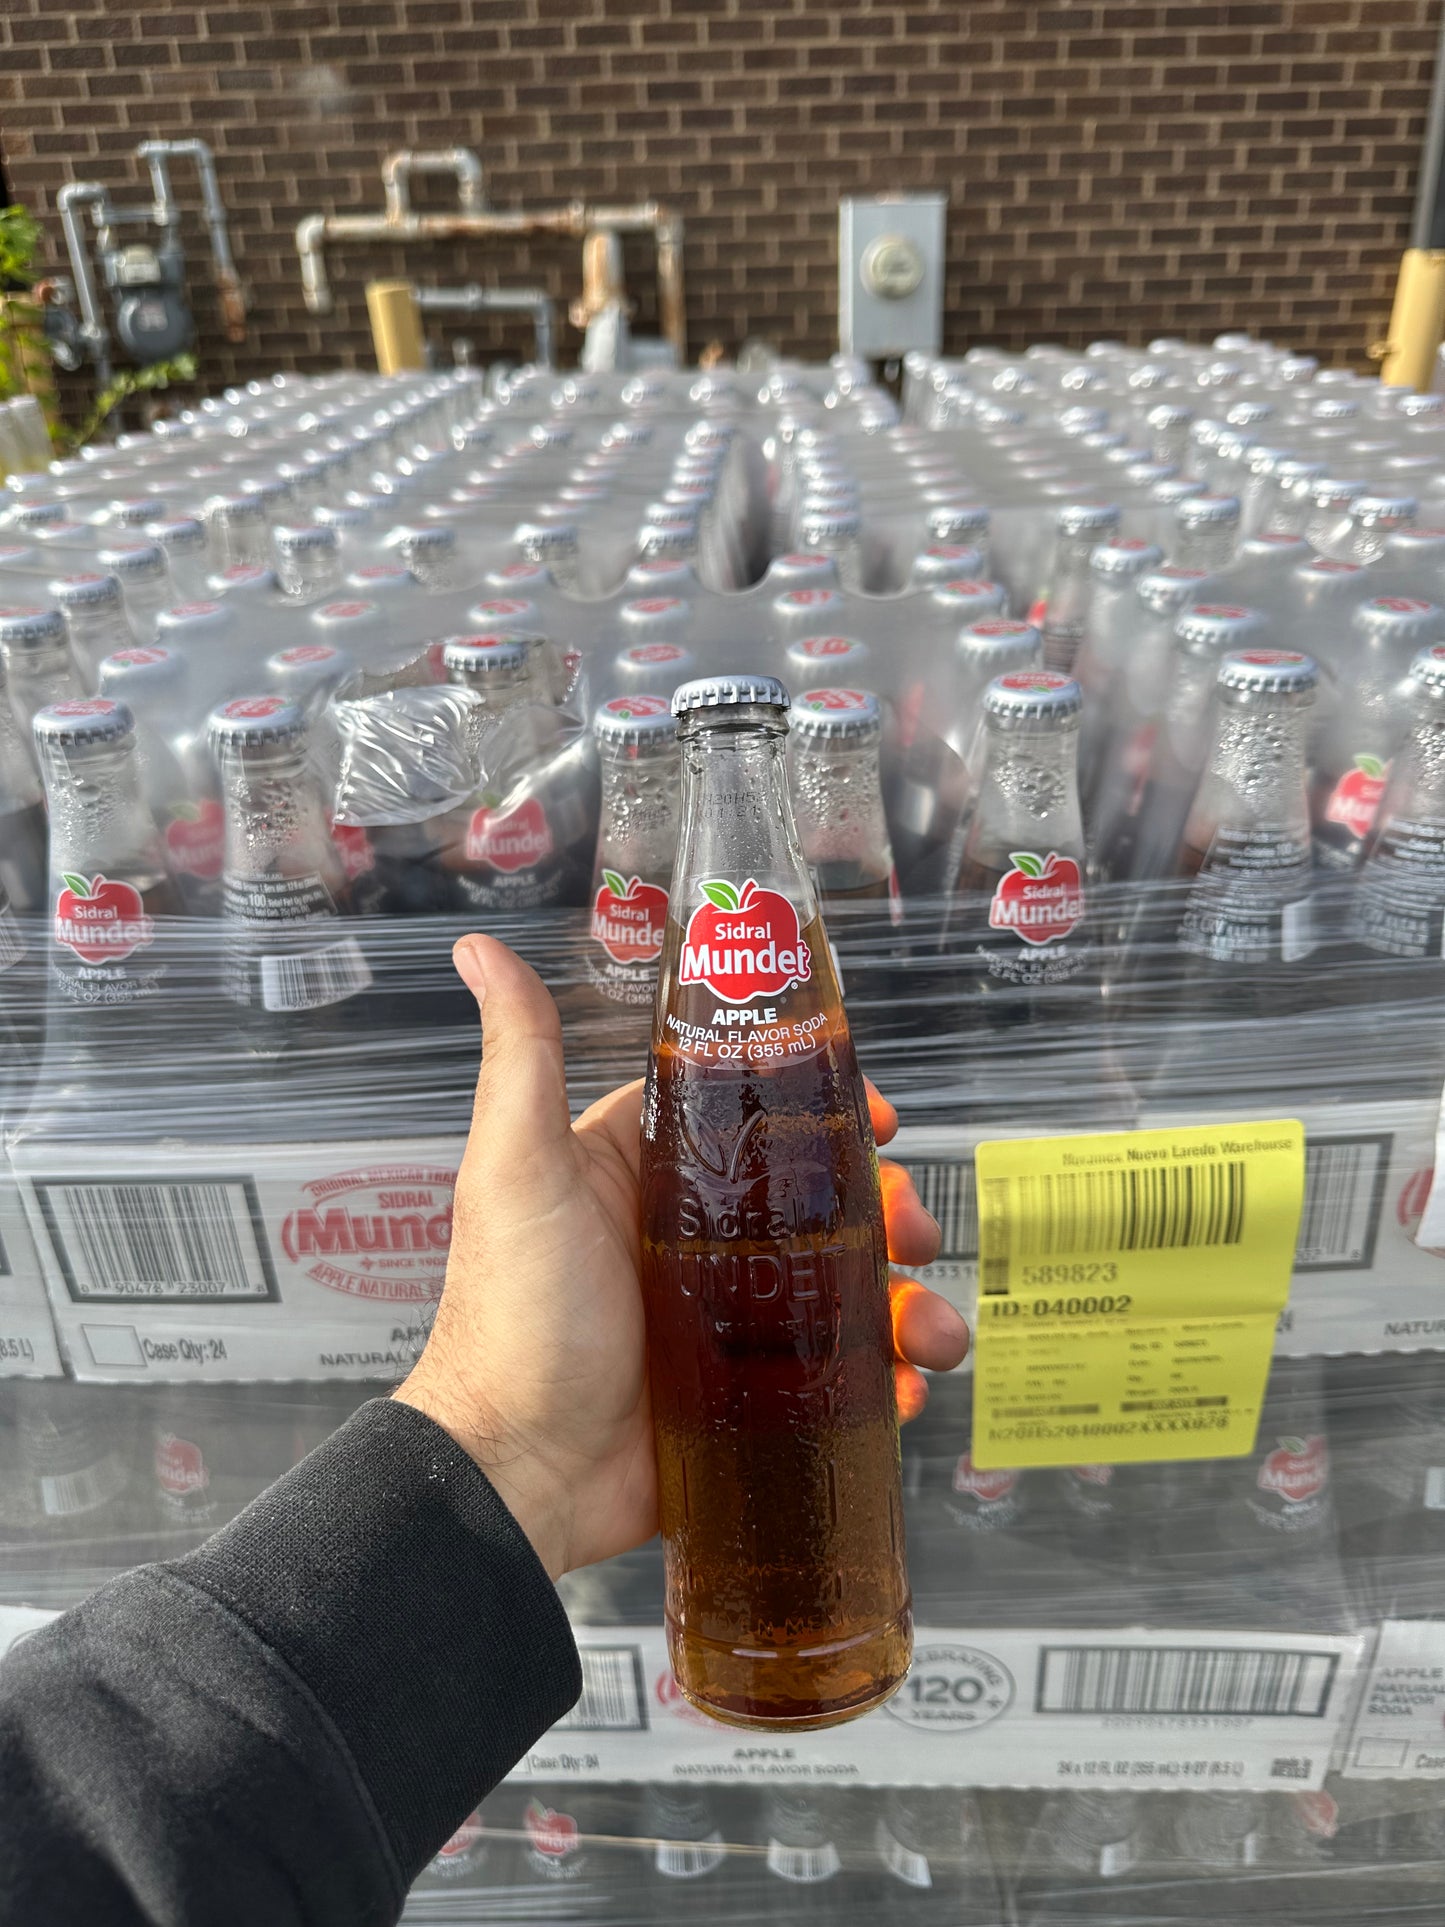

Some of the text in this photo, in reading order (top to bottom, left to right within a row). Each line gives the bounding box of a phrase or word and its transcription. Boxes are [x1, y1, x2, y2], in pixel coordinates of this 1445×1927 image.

[250, 894, 267, 907] 100
[74, 904, 118, 920] Sidral
[610, 903, 650, 921] Sidral
[592, 910, 665, 946] Munde
[714, 921, 772, 941] Sidral
[682, 940, 811, 980] Mundet
[1018, 944, 1067, 961] APPLE
[78, 966, 127, 981] APPLE
[605, 964, 650, 981] APPLE
[711, 1007, 779, 1026] APPLE
[665, 1011, 829, 1045] NATURAL FLAVOR SODA
[677, 1033, 817, 1062] 12 FL OZ (355 mL)
[1126, 1147, 1168, 1162] Nuevo
[1171, 1142, 1217, 1159] Laredo
[1219, 1137, 1293, 1154] Warehouse
[296, 1204, 453, 1256] Mund
[377, 1257, 415, 1269] SINCE
[309, 1262, 356, 1292] APPLE
[359, 1277, 425, 1298] NATURAL
[1020, 1261, 1120, 1288] 589823
[113, 1281, 164, 1295] 90478
[143, 1337, 229, 1364] Case Qty: 24
[906, 1675, 985, 1705] 120
[911, 1709, 976, 1721] YEARS
[732, 1747, 797, 1760] APPLE
